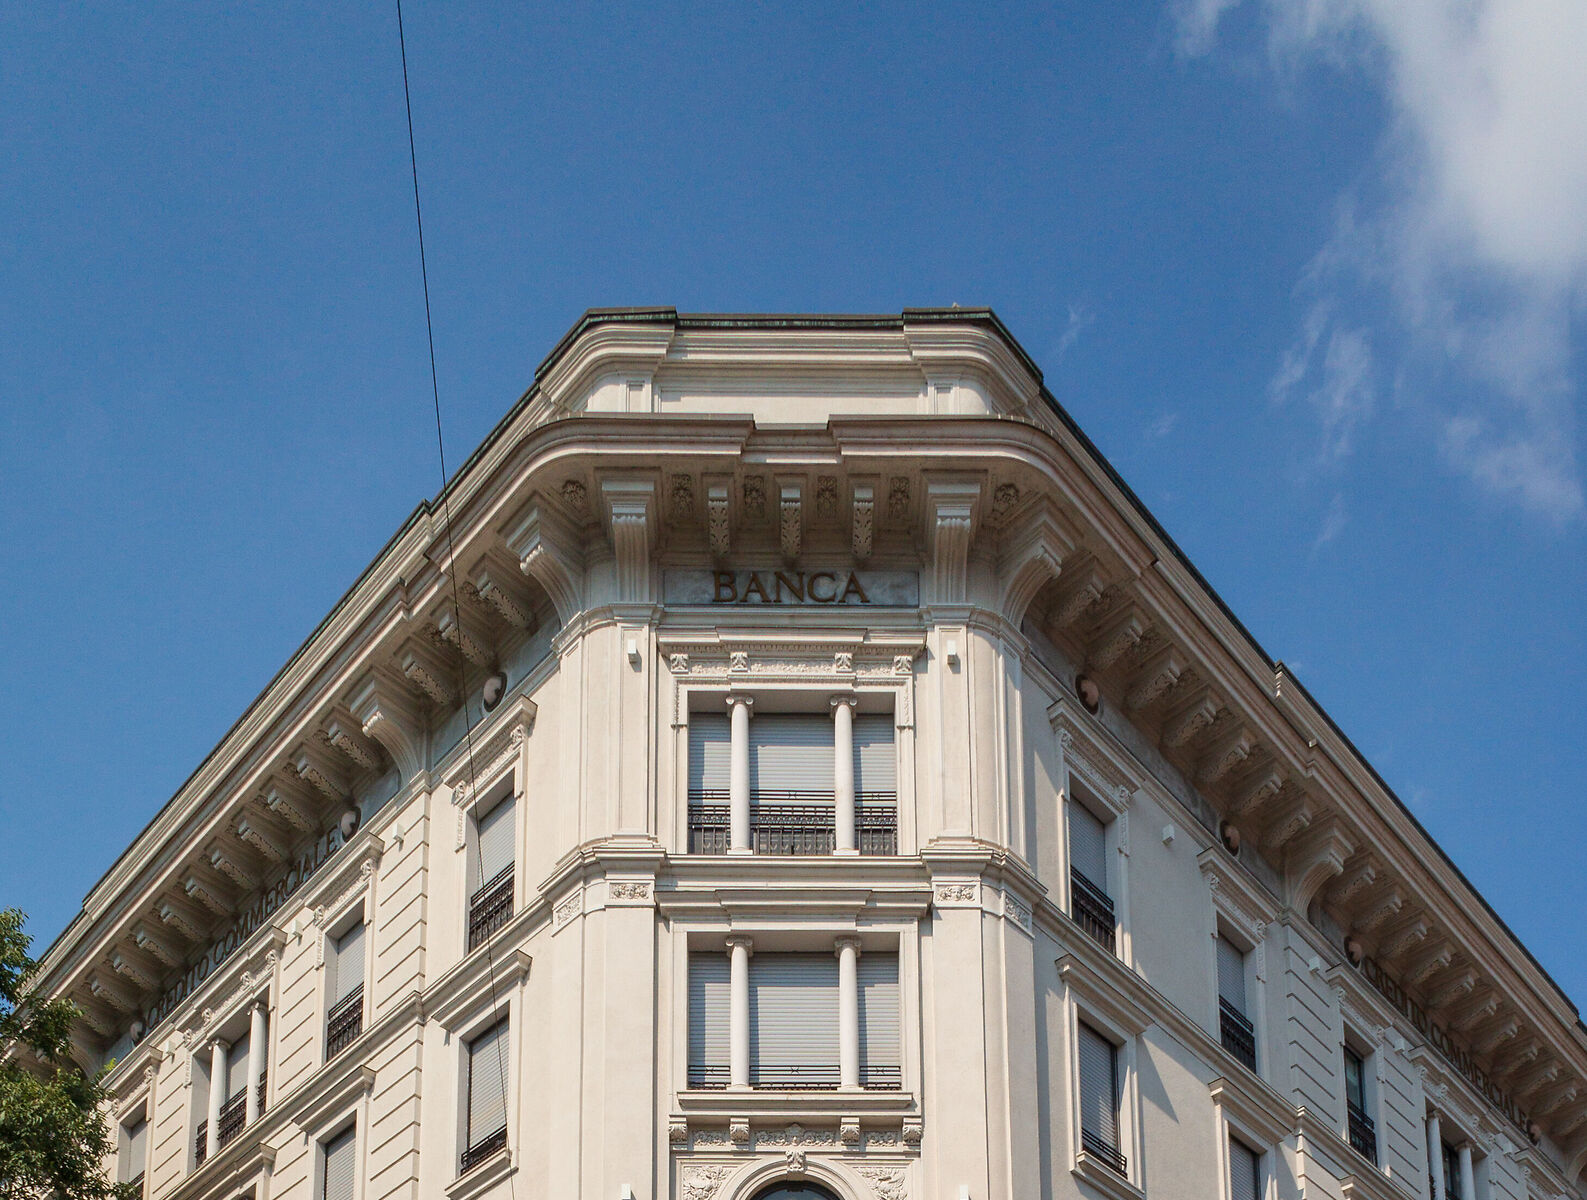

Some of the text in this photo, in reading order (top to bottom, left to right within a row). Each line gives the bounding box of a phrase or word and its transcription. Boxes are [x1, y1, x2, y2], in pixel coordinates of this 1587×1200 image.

[711, 570, 871, 604] BANCA
[147, 825, 340, 1031] CREDITO COMMERCIALE
[1362, 955, 1529, 1136] CREDITO COMMERCIALE
